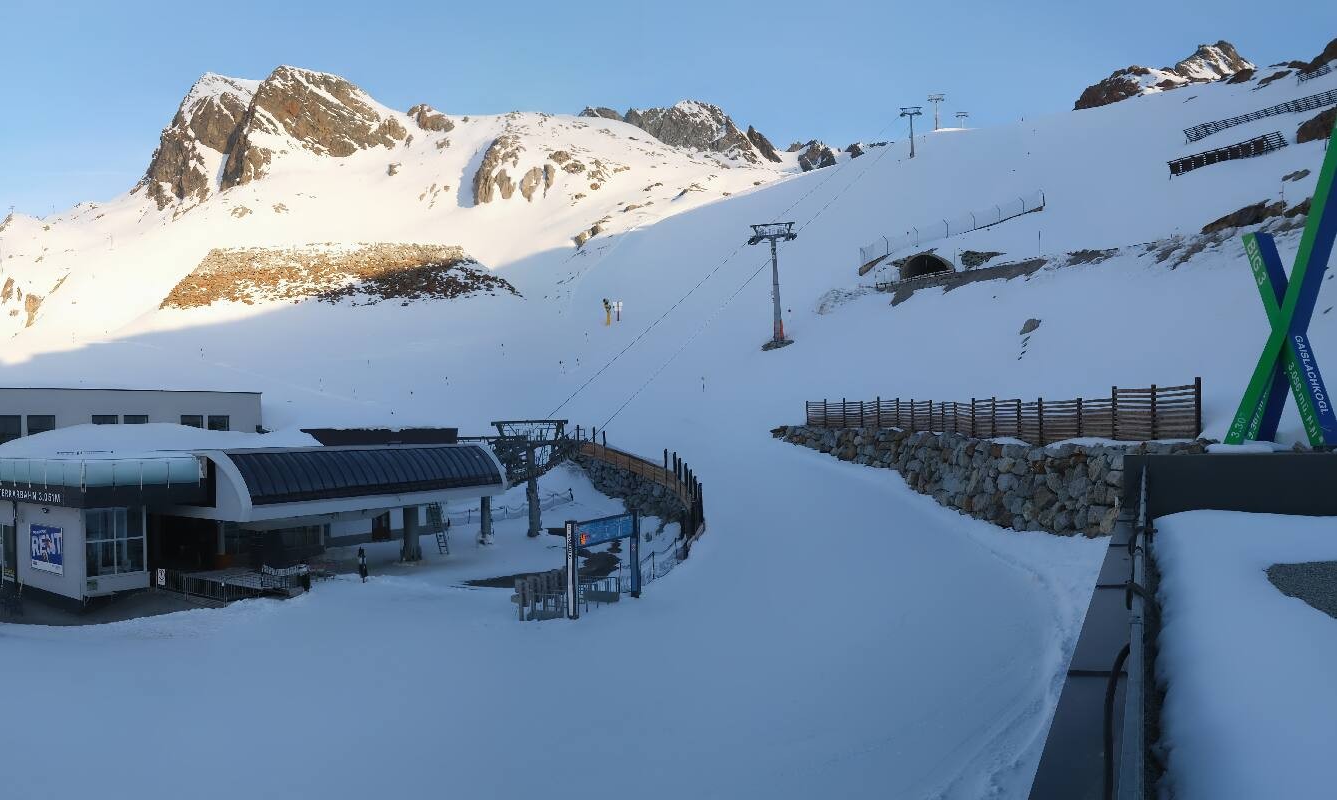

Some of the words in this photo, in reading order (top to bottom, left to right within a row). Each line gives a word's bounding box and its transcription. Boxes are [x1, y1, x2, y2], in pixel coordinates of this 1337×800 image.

[1247, 238, 1262, 272] BIG
[1257, 271, 1267, 286] 3
[1294, 335, 1329, 415] GAISLACHKOGL
